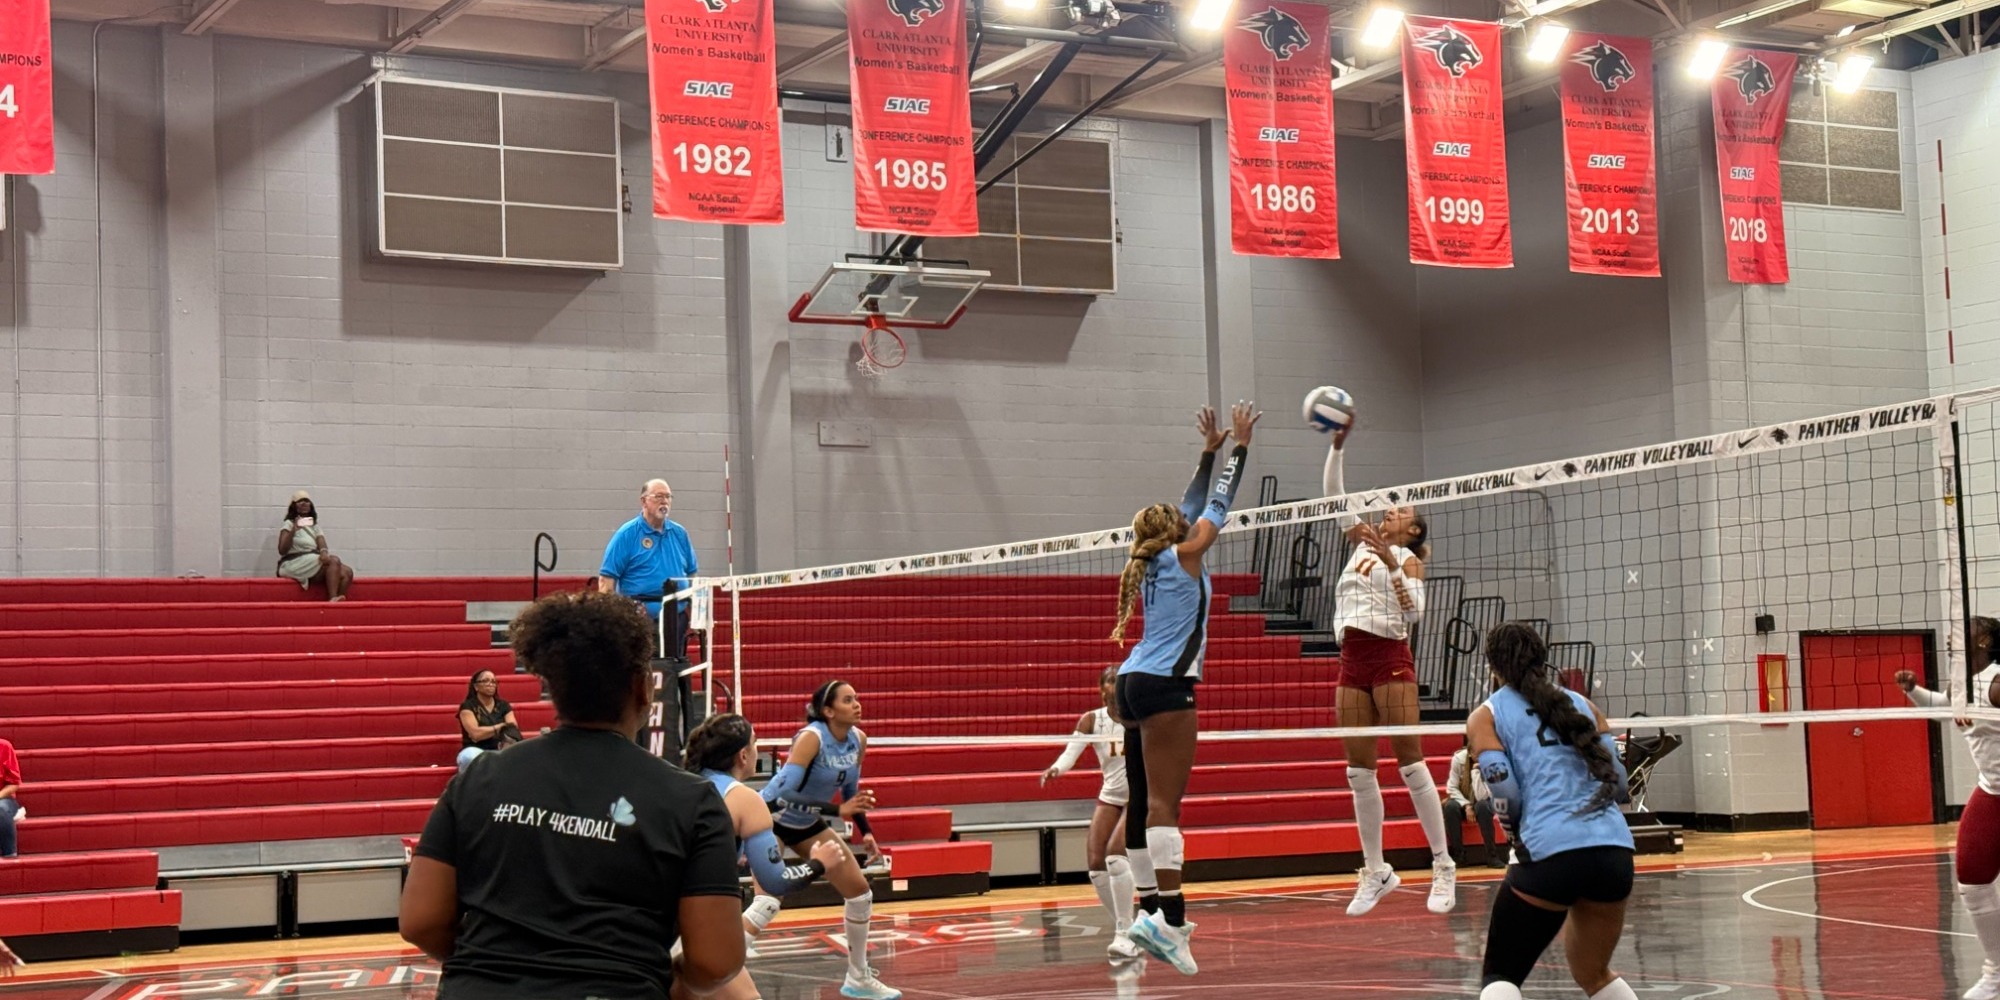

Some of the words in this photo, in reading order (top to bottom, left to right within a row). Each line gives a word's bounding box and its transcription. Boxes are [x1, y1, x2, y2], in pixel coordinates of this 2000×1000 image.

[661, 14, 701, 27] CLARK
[704, 18, 756, 33] ATLANTA
[675, 28, 745, 44] UNIVERSITY
[862, 28, 900, 41] CLARK
[903, 33, 952, 46] ATLANTA
[707, 47, 766, 63] Basketball
[875, 42, 941, 57] UNIVERSITY
[906, 60, 960, 75] Basketball
[1239, 63, 1271, 74] CLARK
[684, 80, 734, 99] SIAC
[1250, 76, 1308, 89] UNIVERSITY
[1230, 89, 1274, 101] Women's
[884, 97, 932, 114] SIAC
[718, 117, 771, 131] CHAMPIONS
[1604, 121, 1647, 133] Basketba
[917, 133, 965, 147] CHAMPIONS
[1259, 127, 1300, 143] SIAC
[1433, 141, 1472, 157] SIAC
[673, 142, 752, 177] 1982
[1587, 154, 1626, 169] SIAC
[874, 158, 947, 191] 1985
[1730, 166, 1755, 180] SIAC
[689, 192, 715, 203] NCAA
[1250, 183, 1316, 213] 1986
[1425, 196, 1485, 226] 1999
[1580, 207, 1640, 235] 2013
[1729, 216, 1767, 243] 2018
[1798, 415, 1860, 440] PANTHER
[1584, 452, 1637, 474] PANTHER
[1642, 439, 1713, 465] VOLLEYBALL
[1216, 456, 1239, 495] BLUE
[1406, 483, 1450, 502] PANTHER
[1455, 472, 1515, 495] VOLLEYBALL
[1255, 506, 1292, 524] PANTHER
[1297, 499, 1348, 520] VOLLEYBALL
[1010, 542, 1038, 557] PANTHER
[1042, 538, 1080, 553] VOLLEYBALL
[910, 556, 936, 569] PANTHER
[835, 770, 847, 787] 9
[776, 797, 822, 815] BLUE
[493, 803, 547, 827] #PLAY
[548, 812, 616, 842] 4KENDALL
[782, 863, 814, 880] BLUE
